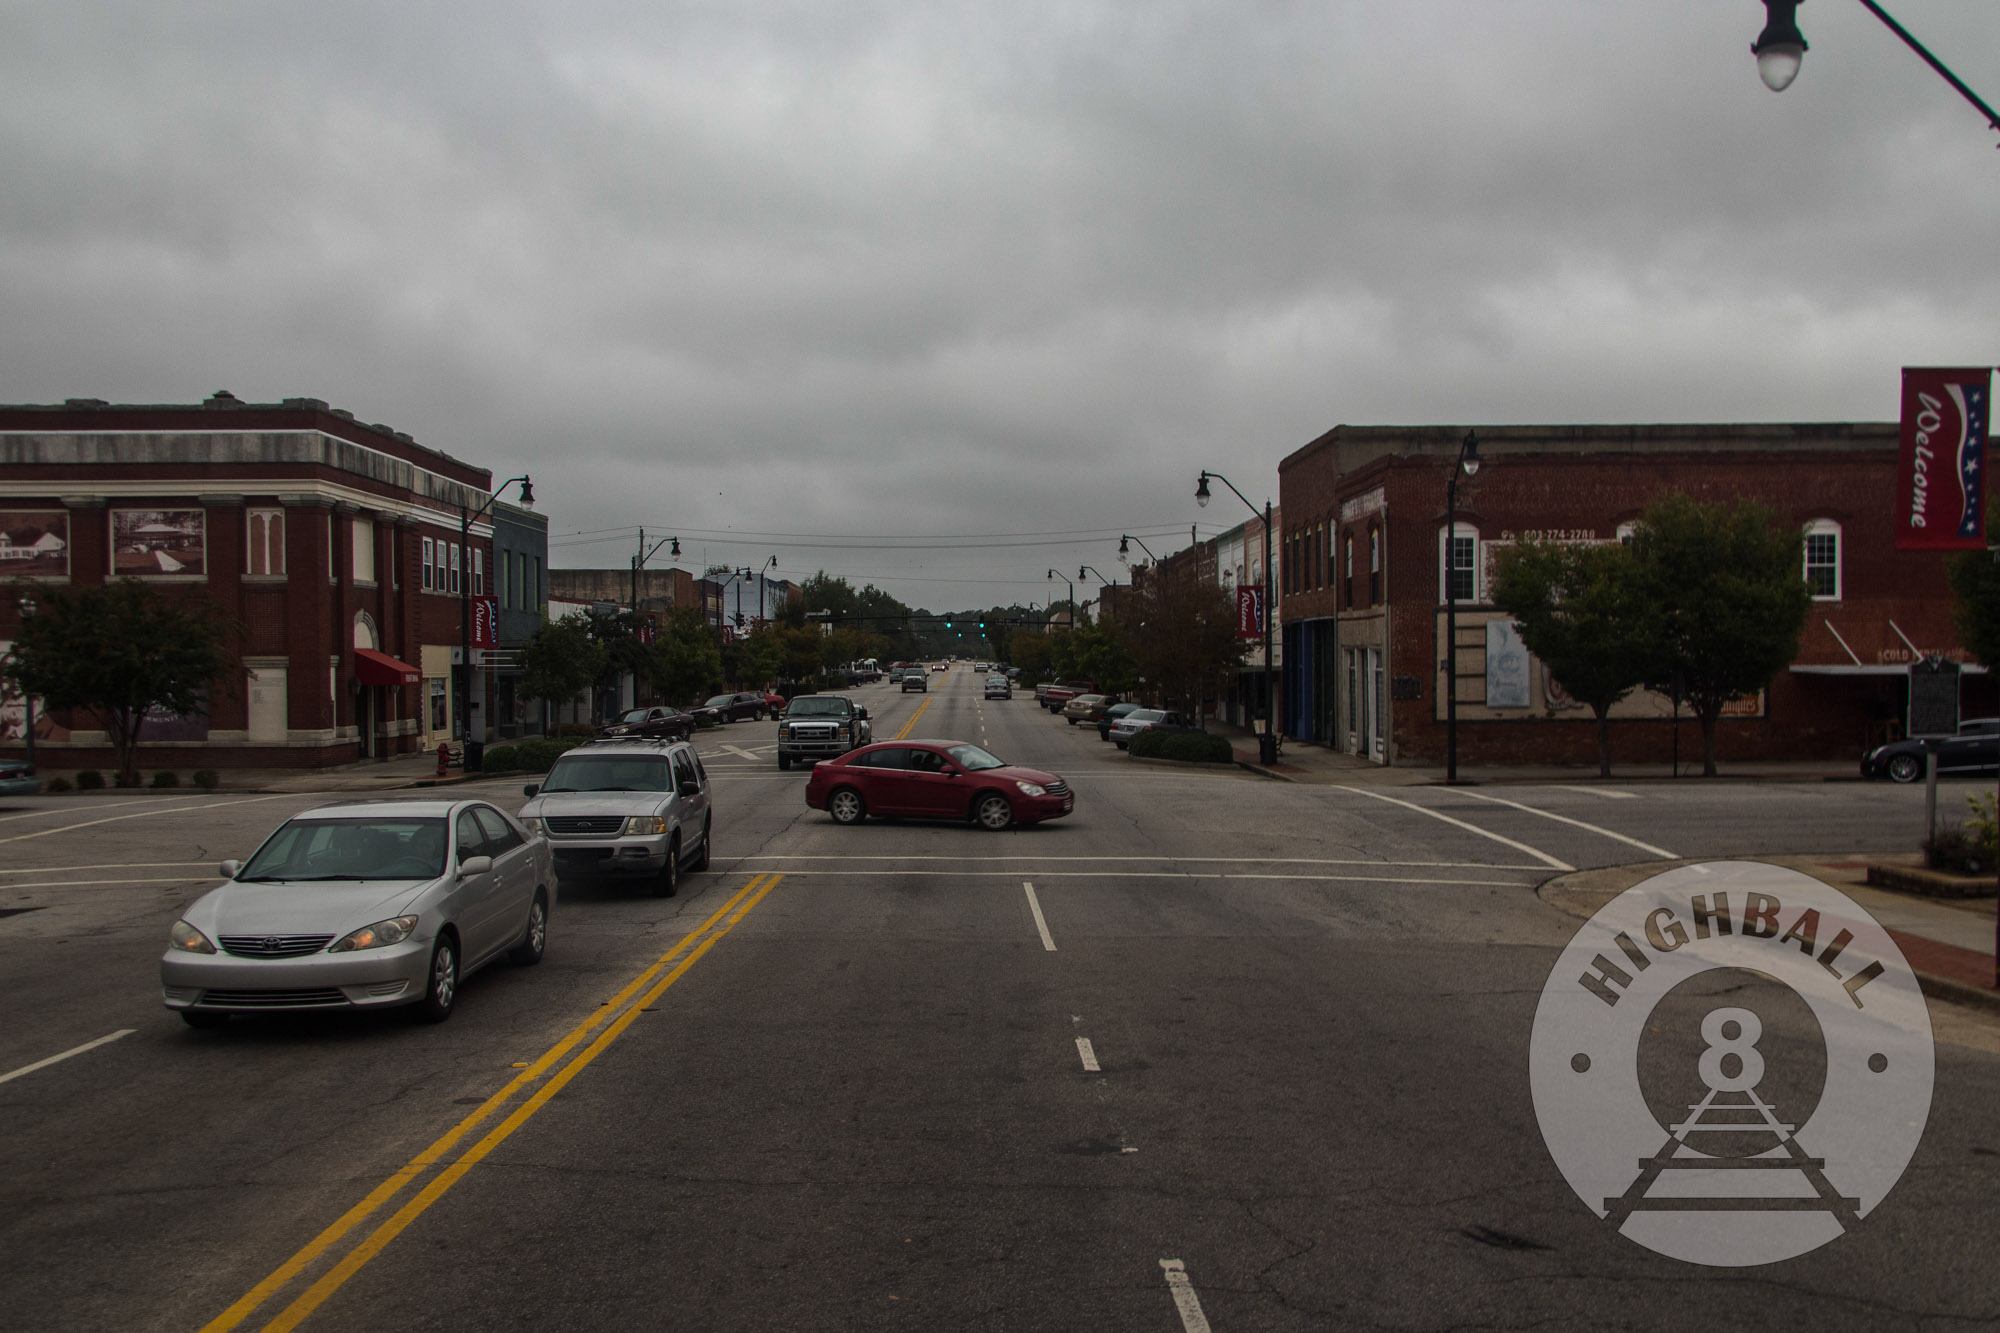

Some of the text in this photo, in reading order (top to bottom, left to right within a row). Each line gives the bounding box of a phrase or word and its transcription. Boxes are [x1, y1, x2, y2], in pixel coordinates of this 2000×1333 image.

[1910, 391, 1943, 529] Welcome
[475, 602, 485, 642] Welcome
[1241, 592, 1250, 632] Welcome
